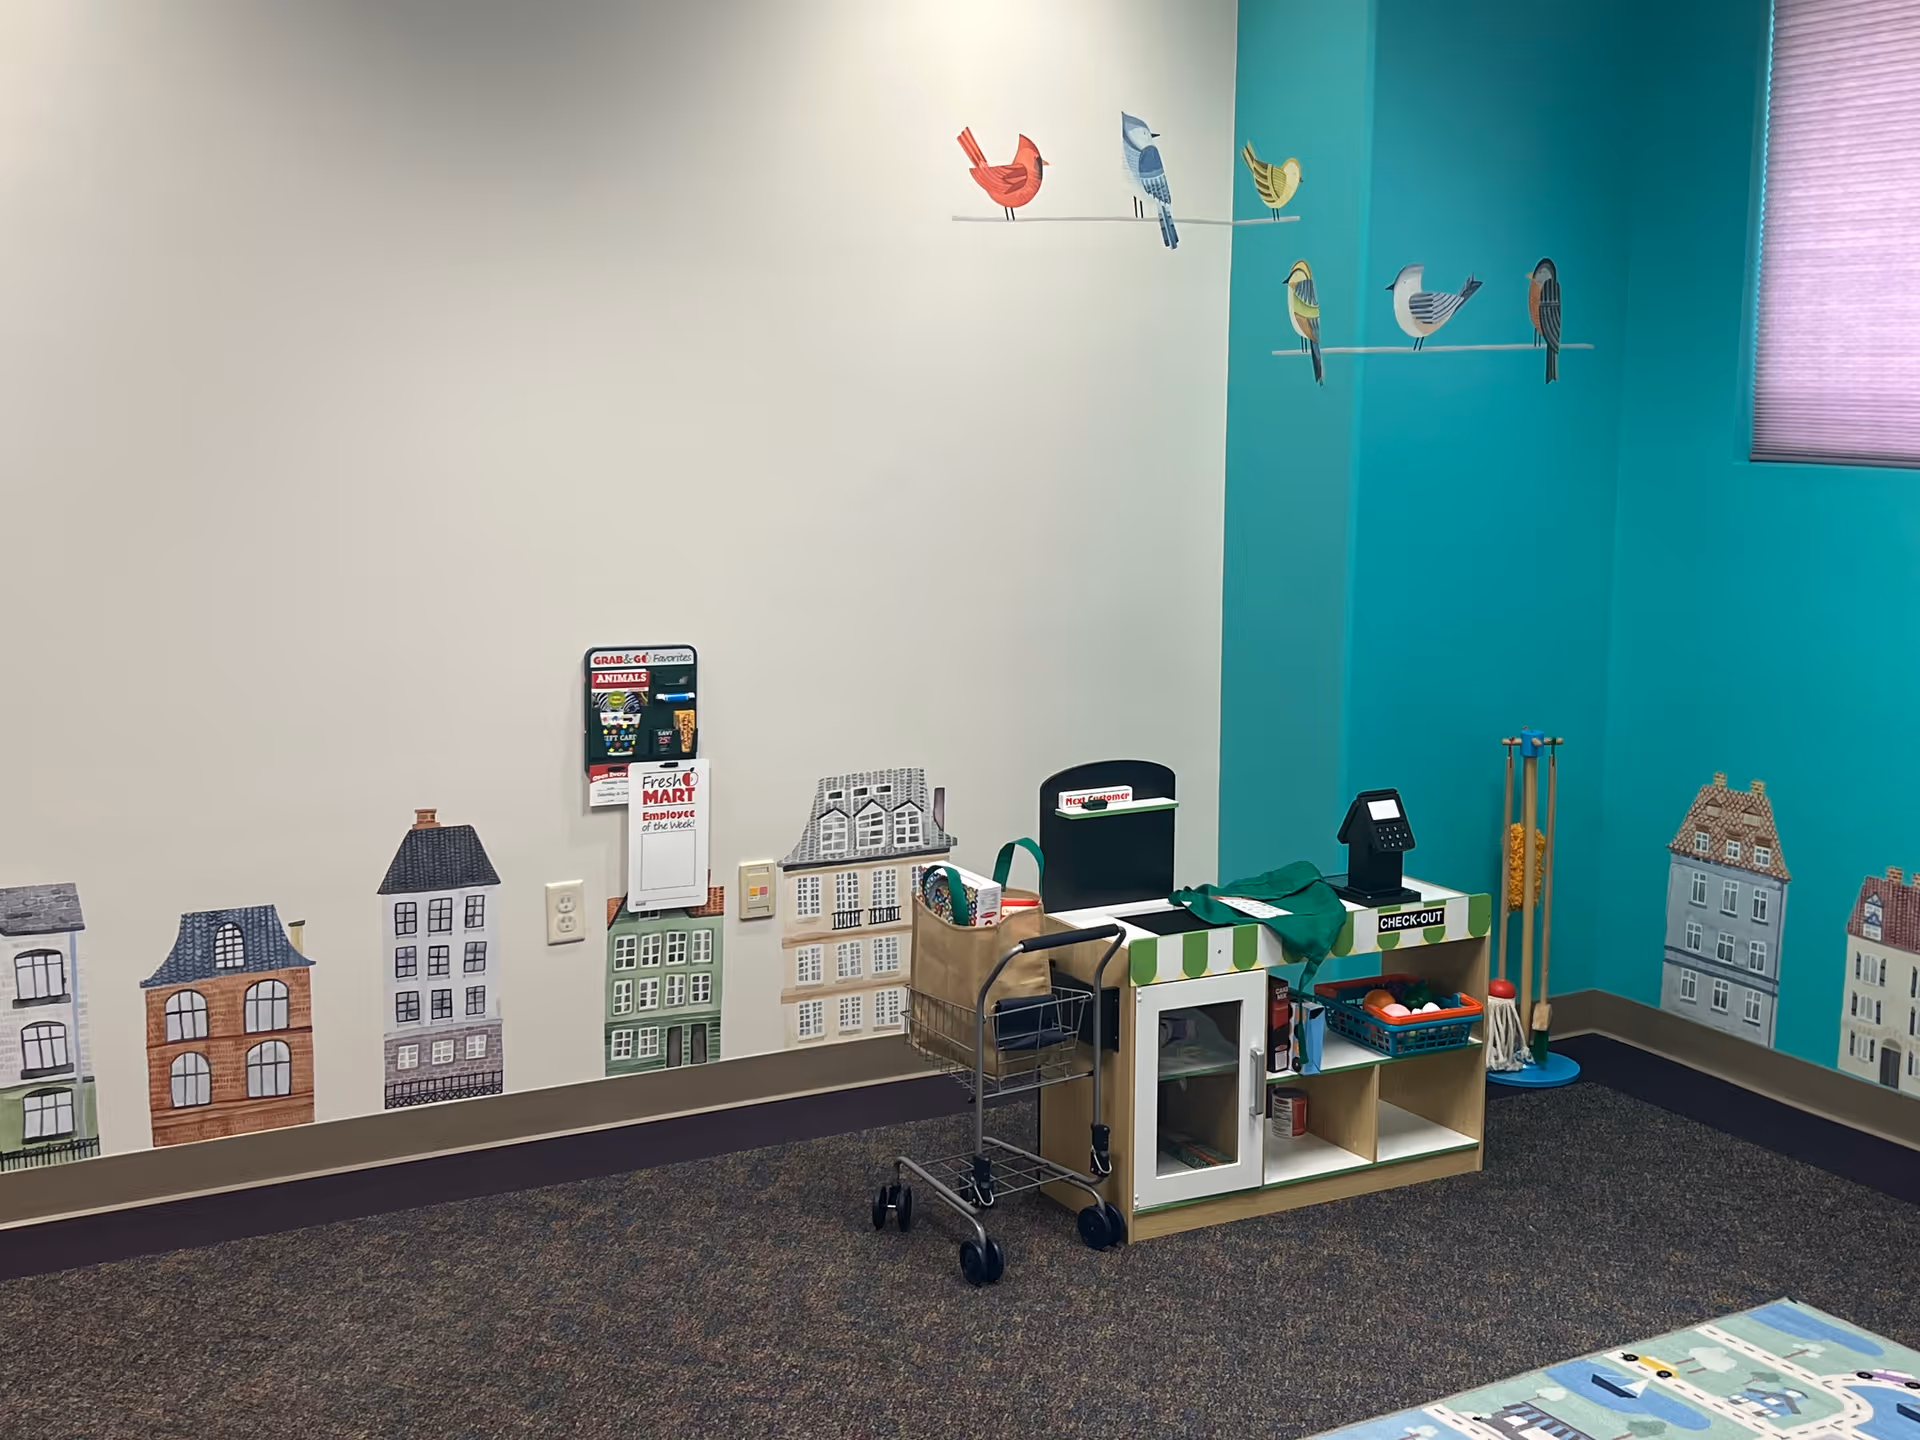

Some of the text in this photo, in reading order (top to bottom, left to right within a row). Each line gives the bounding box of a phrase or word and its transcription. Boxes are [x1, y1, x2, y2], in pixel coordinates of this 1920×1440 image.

[653, 653, 692, 662] Favorites
[596, 673, 647, 683] ANIMALS
[642, 774, 681, 789] Fresh
[643, 787, 695, 805] MART
[1065, 792, 1130, 806] Next Customer
[642, 810, 695, 821] Employee
[642, 819, 695, 831] of the Week!
[1380, 911, 1443, 929] CHECK-OUT
